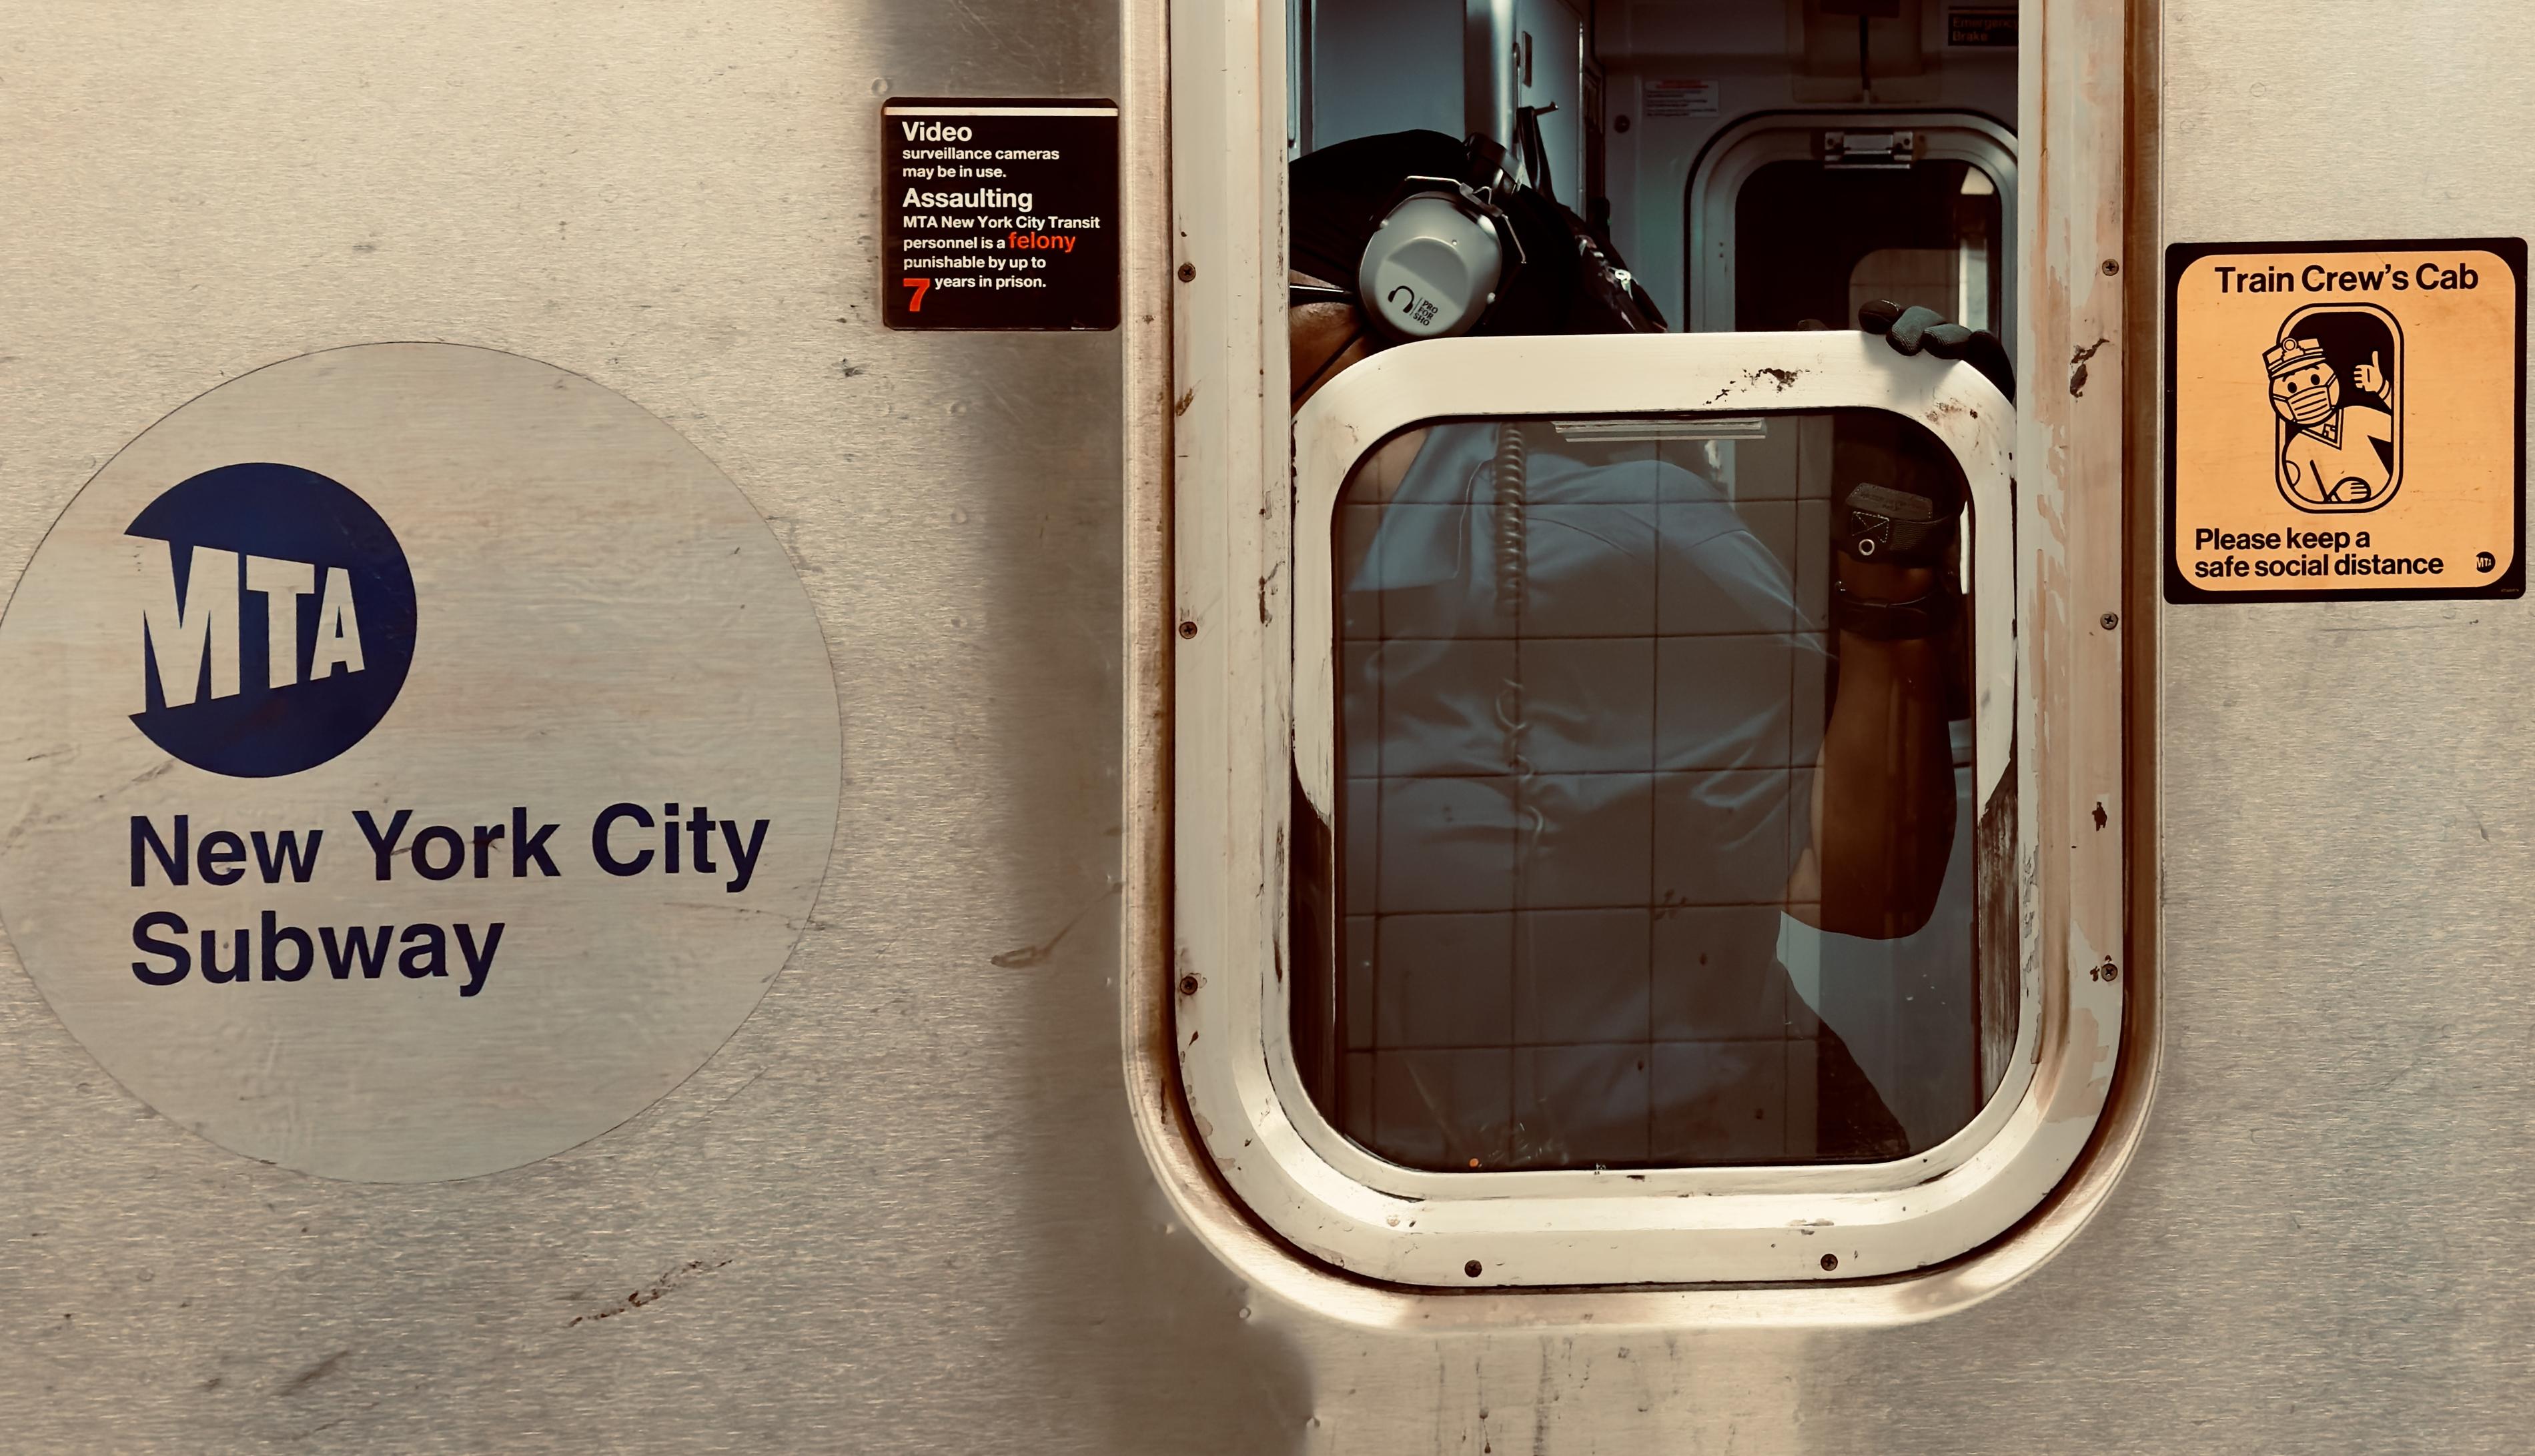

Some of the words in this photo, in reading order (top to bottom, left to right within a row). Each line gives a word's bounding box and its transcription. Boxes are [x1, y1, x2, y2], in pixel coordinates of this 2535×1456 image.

[1953, 31, 1989, 41] Brake
[901, 121, 973, 142] Video
[903, 147, 993, 160] surveillance
[995, 149, 1060, 160] cameras
[903, 167, 935, 180] may
[937, 165, 957, 177] be
[959, 165, 973, 177] in
[975, 167, 1007, 178] use.
[902, 187, 1033, 213] Assaulting
[903, 215, 939, 228] MTA
[941, 215, 975, 229] New
[977, 215, 1013, 229] York
[1015, 215, 1045, 231] City
[1047, 215, 1101, 229] Transit
[903, 236, 978, 251] personnel
[981, 236, 994, 249] is
[996, 239, 1005, 249] a
[1008, 231, 1076, 253] felony
[903, 255, 985, 271] punishable
[988, 255, 1007, 271] by
[1009, 258, 1029, 271] up
[1031, 256, 1047, 269] to
[2214, 265, 2294, 293] Train
[2302, 263, 2409, 292] Crew's
[2416, 262, 2479, 290] Cab
[903, 277, 931, 312] 7
[934, 277, 976, 290] years
[979, 275, 993, 287] in
[995, 275, 1047, 290] prison.
[1418, 307, 1434, 320] FOR
[1422, 300, 1438, 314] PRO
[1413, 313, 1430, 326] SHO
[2195, 528, 2282, 550] Please
[2287, 527, 2351, 553] keep
[2355, 531, 2370, 548] a
[2195, 555, 2250, 578] safe
[2254, 554, 2329, 577] social
[2336, 552, 2444, 576] distance
[2476, 556, 2492, 568] MTA
[131, 537, 366, 712] MTA
[130, 814, 324, 887] New
[352, 806, 561, 881] York
[592, 802, 771, 893] City
[131, 910, 506, 998] Subway
